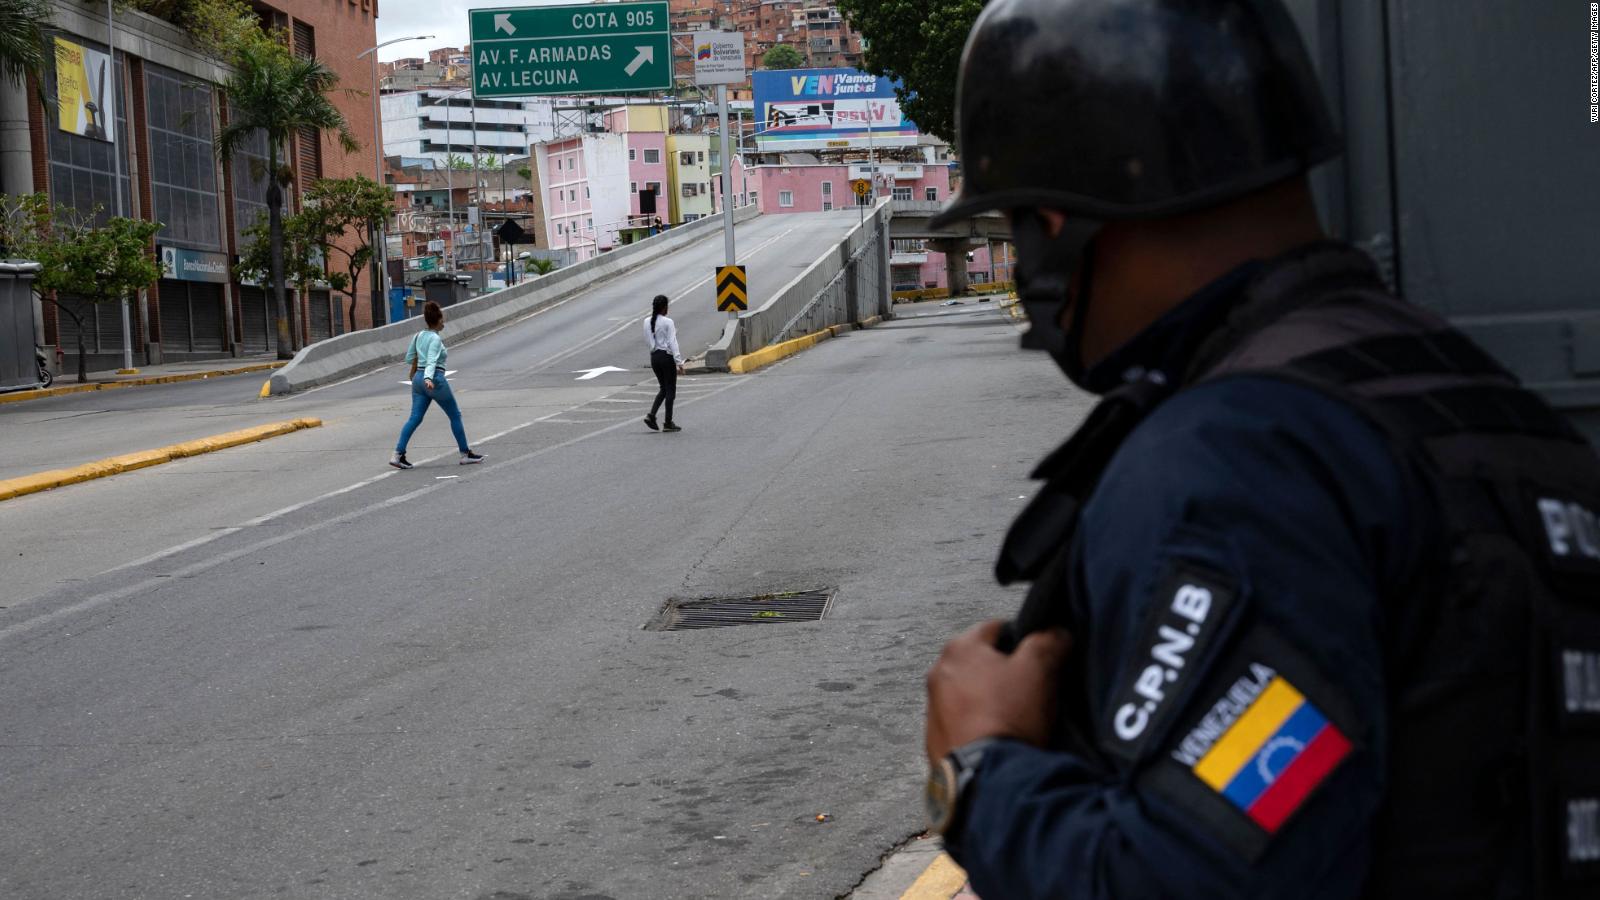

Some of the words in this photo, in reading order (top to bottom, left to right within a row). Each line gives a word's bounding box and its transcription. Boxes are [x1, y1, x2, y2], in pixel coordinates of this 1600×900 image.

[572, 12, 618, 29] COTA
[626, 11, 654, 26] 905
[479, 49, 506, 65] AV.
[510, 49, 524, 64] F.
[528, 45, 612, 63] ARMADAS
[480, 72, 507, 88] AV.
[511, 69, 579, 87] LECUNA
[791, 75, 833, 96] VEN
[1114, 583, 1213, 742] C.P.N.B
[1171, 662, 1278, 767] VENEZUELA
